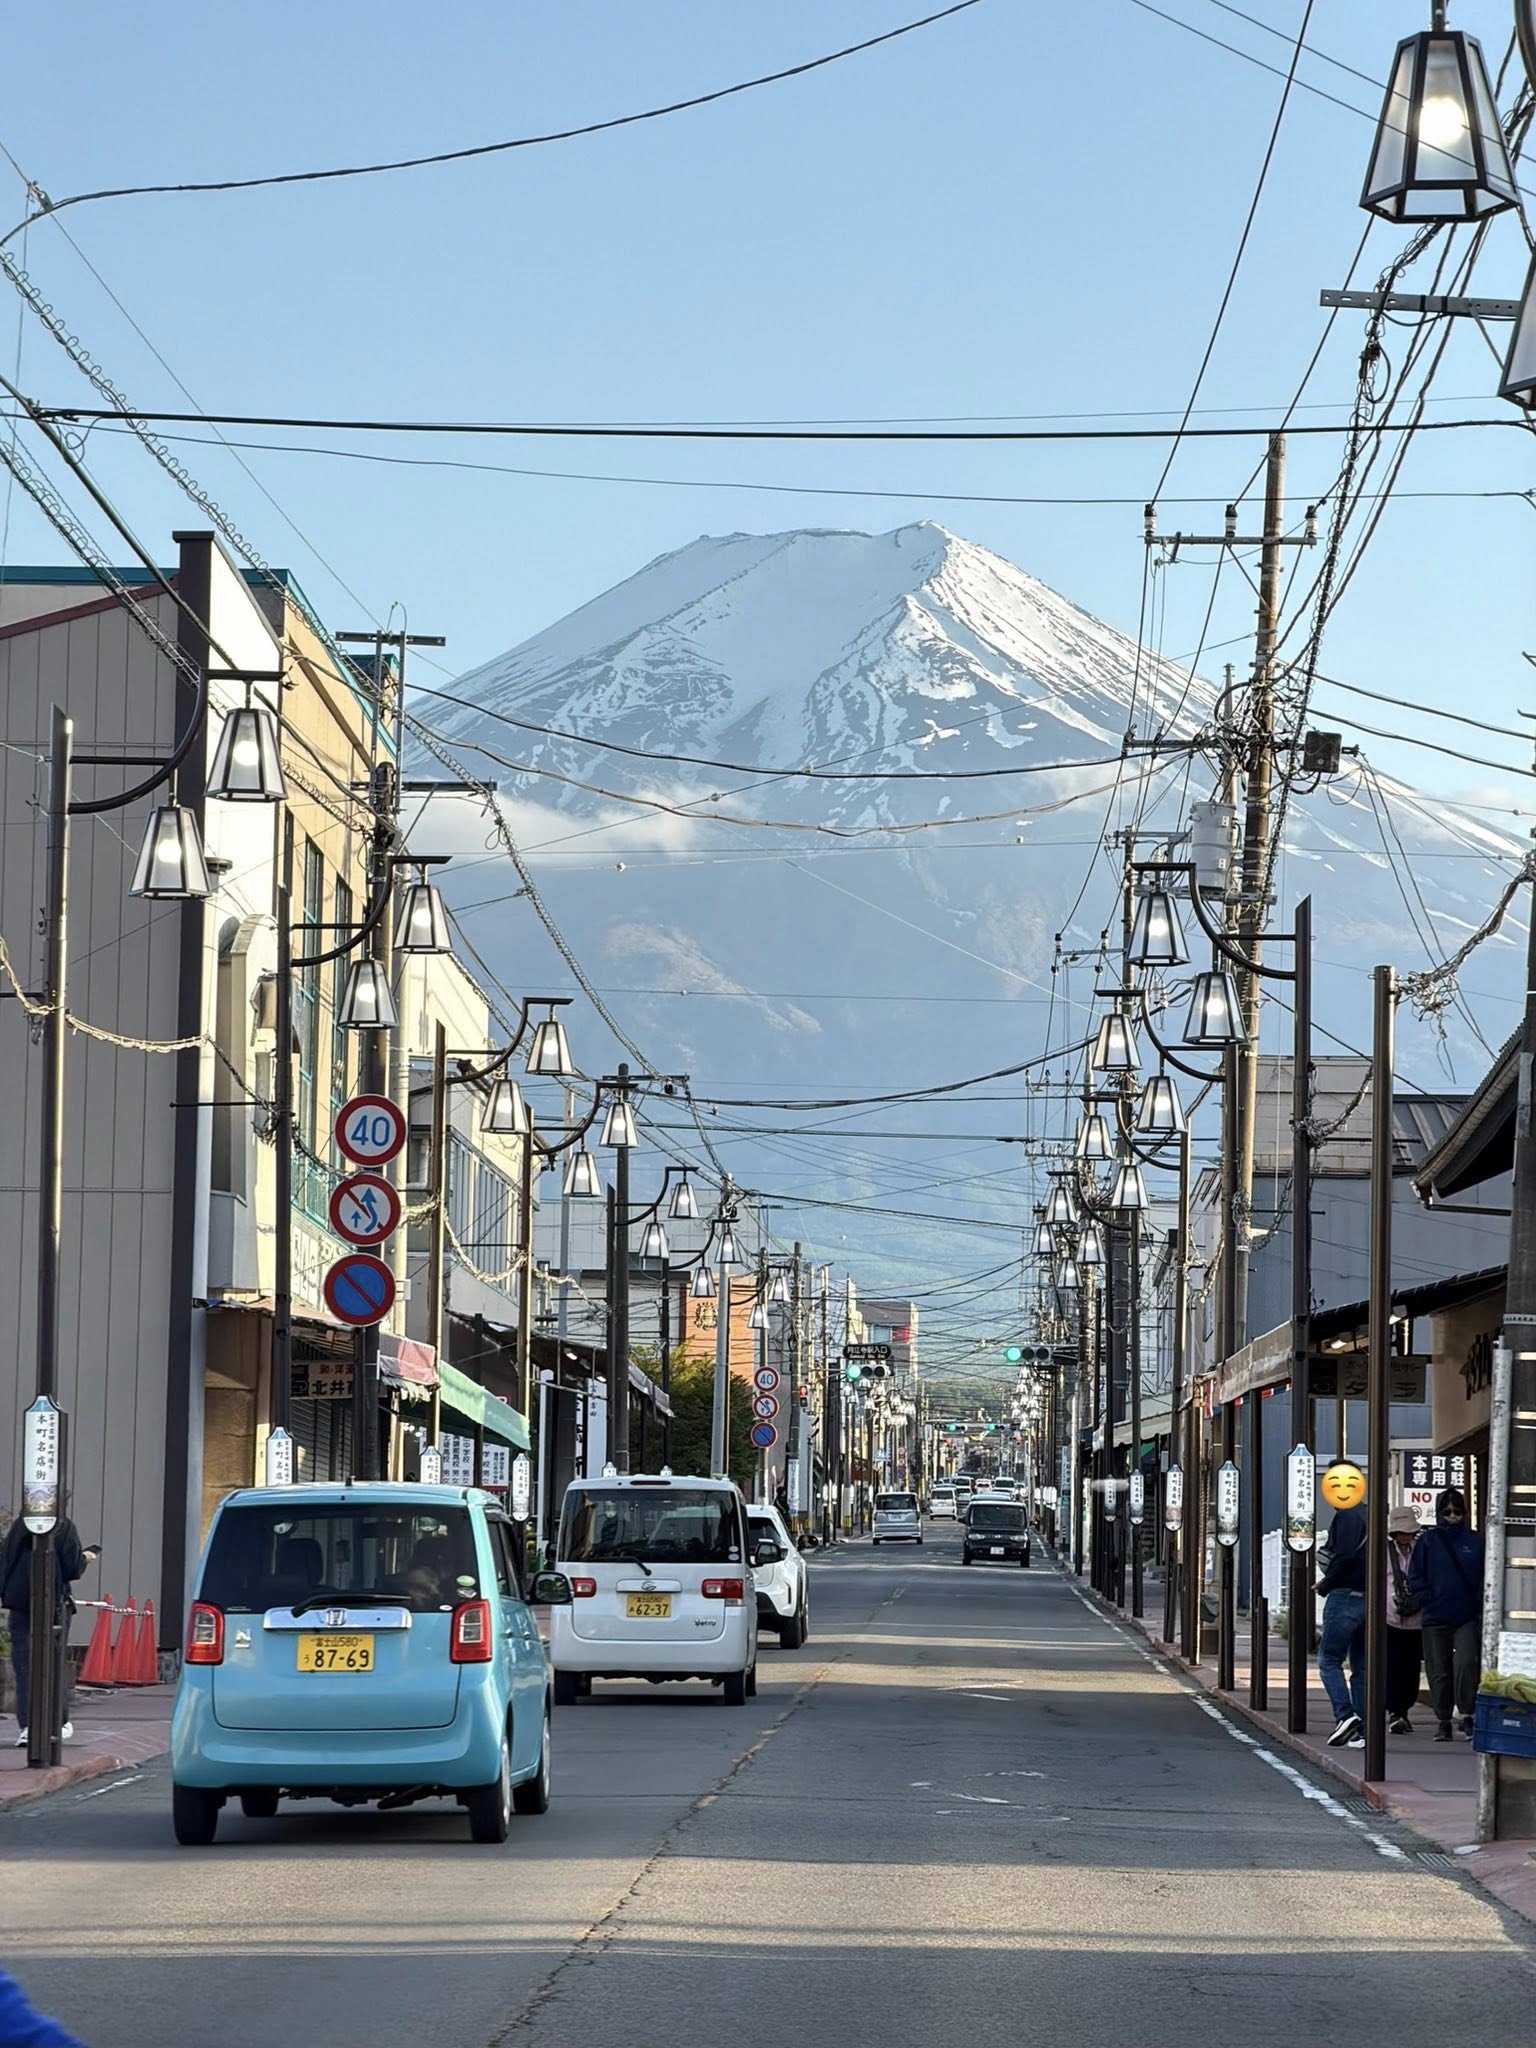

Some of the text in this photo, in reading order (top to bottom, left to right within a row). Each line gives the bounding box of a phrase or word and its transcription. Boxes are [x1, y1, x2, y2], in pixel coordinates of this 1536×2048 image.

[351, 1115, 390, 1147] 40
[760, 1374, 774, 1385] 40
[36, 1414, 47, 1480] 本町名店街
[275, 1441, 284, 1485] 本町名店
[1297, 1458, 1305, 1509] 本町名店街
[1411, 1492, 1432, 1503] NO
[636, 1604, 669, 1616] 62-37
[315, 1649, 369, 1668] 87-69
